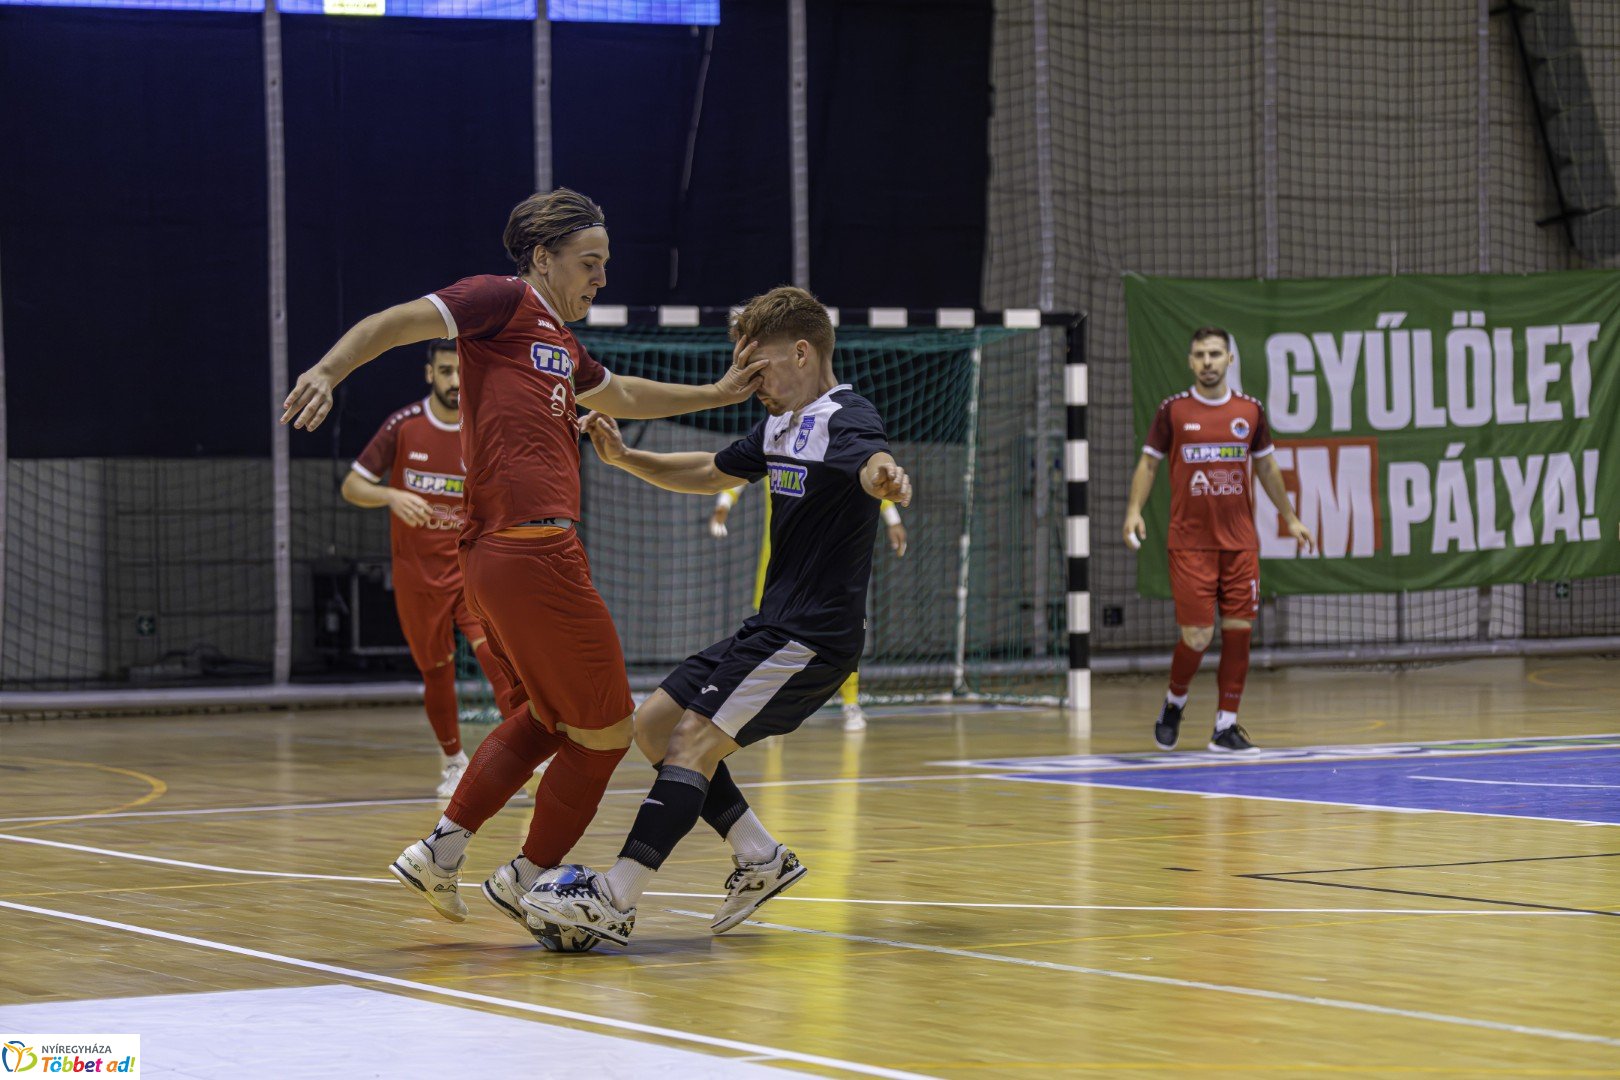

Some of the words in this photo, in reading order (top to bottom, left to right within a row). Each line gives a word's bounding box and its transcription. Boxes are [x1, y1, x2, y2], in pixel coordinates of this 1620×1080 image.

[1265, 310, 1601, 433] GYŰLÖLET
[1253, 444, 1375, 559] EM
[1388, 442, 1602, 557] PÁLYA!
